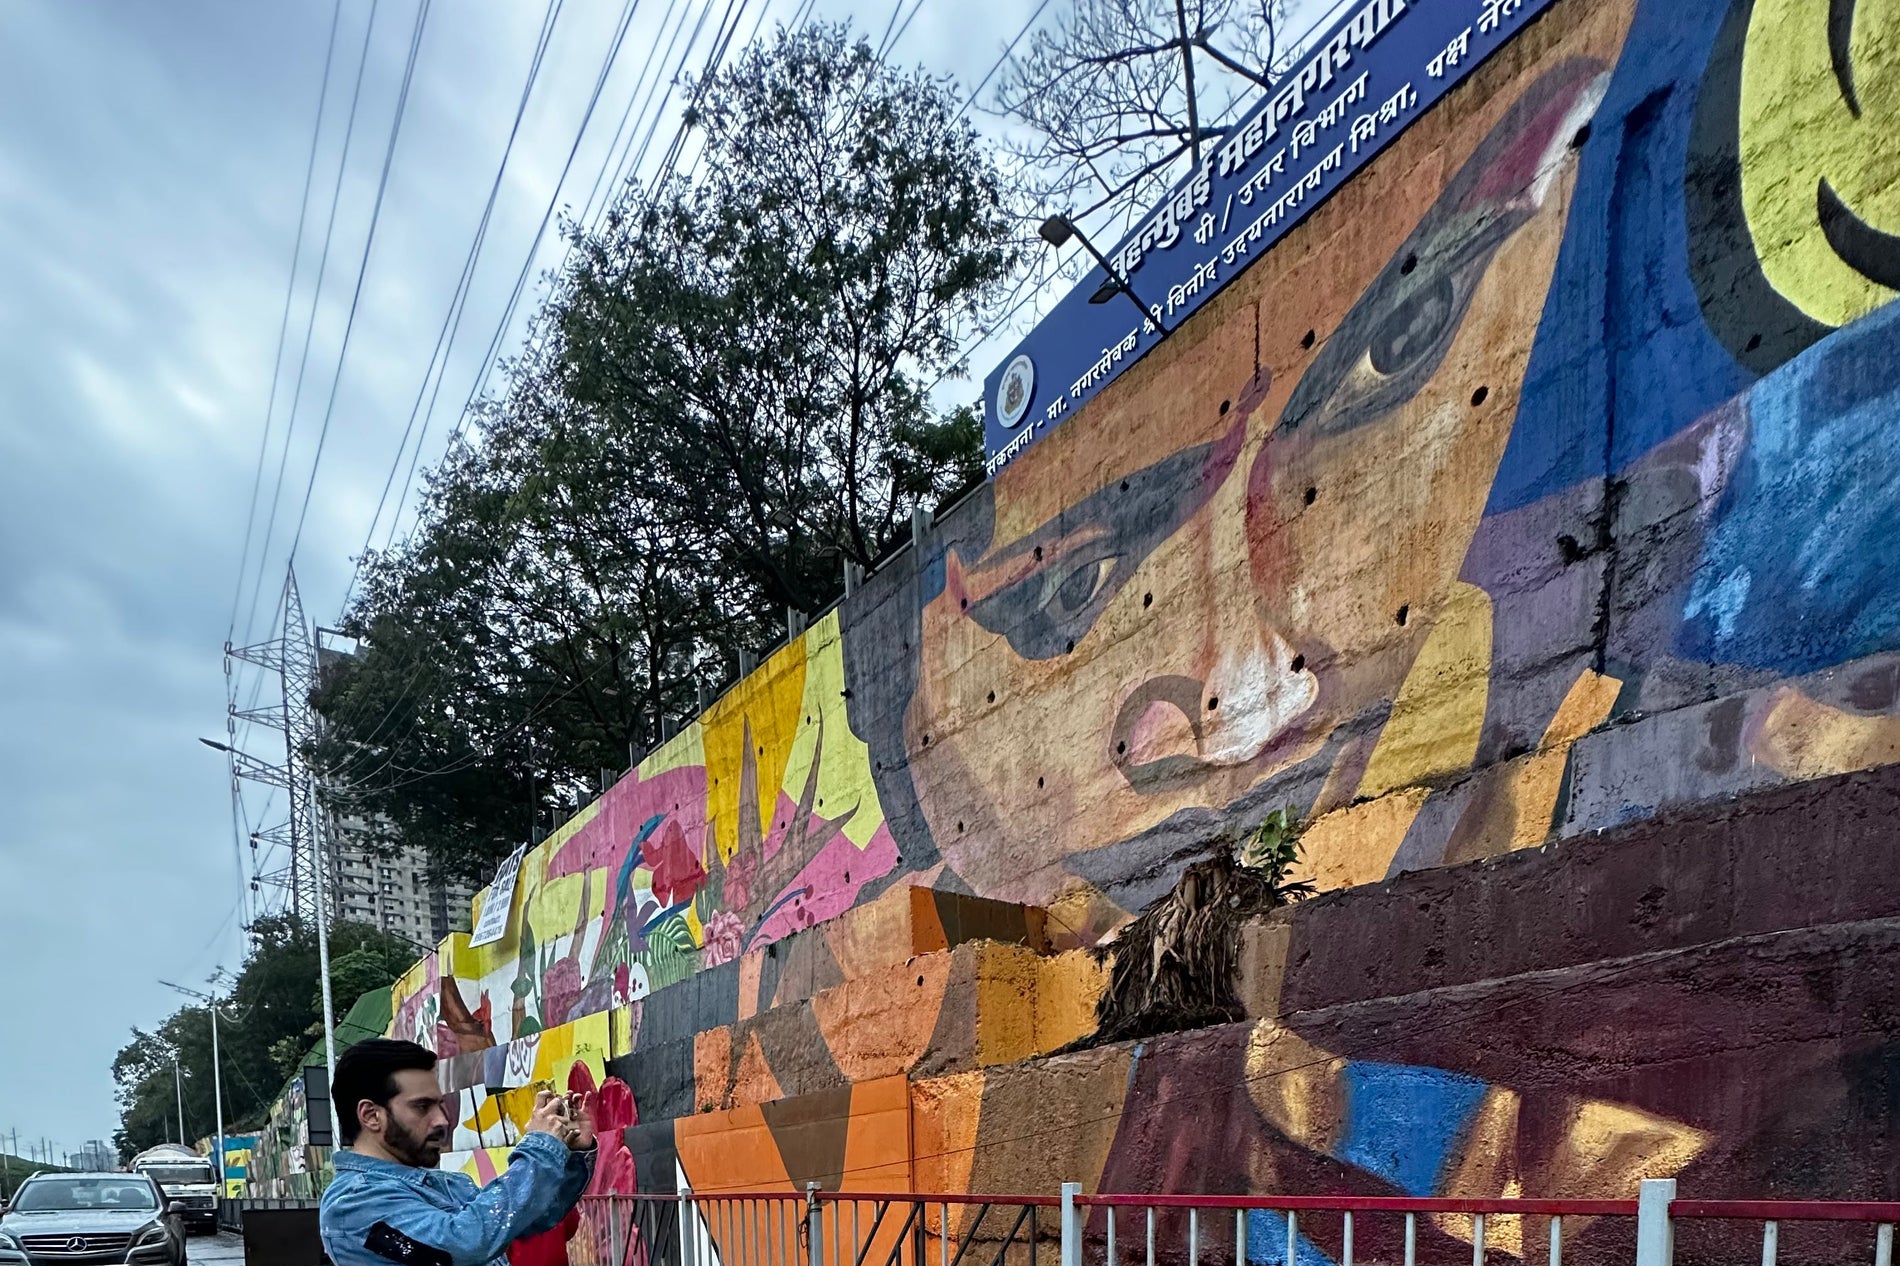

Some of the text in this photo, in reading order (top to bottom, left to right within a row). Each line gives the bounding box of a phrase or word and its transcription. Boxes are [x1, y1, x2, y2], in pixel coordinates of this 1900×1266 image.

[1193, 213, 1216, 244] पी
[1237, 148, 1286, 204] उत्तर
[1290, 70, 1369, 159] विभाग
[1217, 0, 1407, 176] महानगरपा
[984, 422, 1034, 476] संकल्पना
[1046, 395, 1067, 420] मा.
[1070, 327, 1138, 399] नगरसेवक
[1166, 255, 1218, 316] विनोद
[1221, 142, 1344, 263] उदयनारायण
[1349, 82, 1417, 152] मिश्रा,
[1425, 27, 1472, 77] पक्ष
